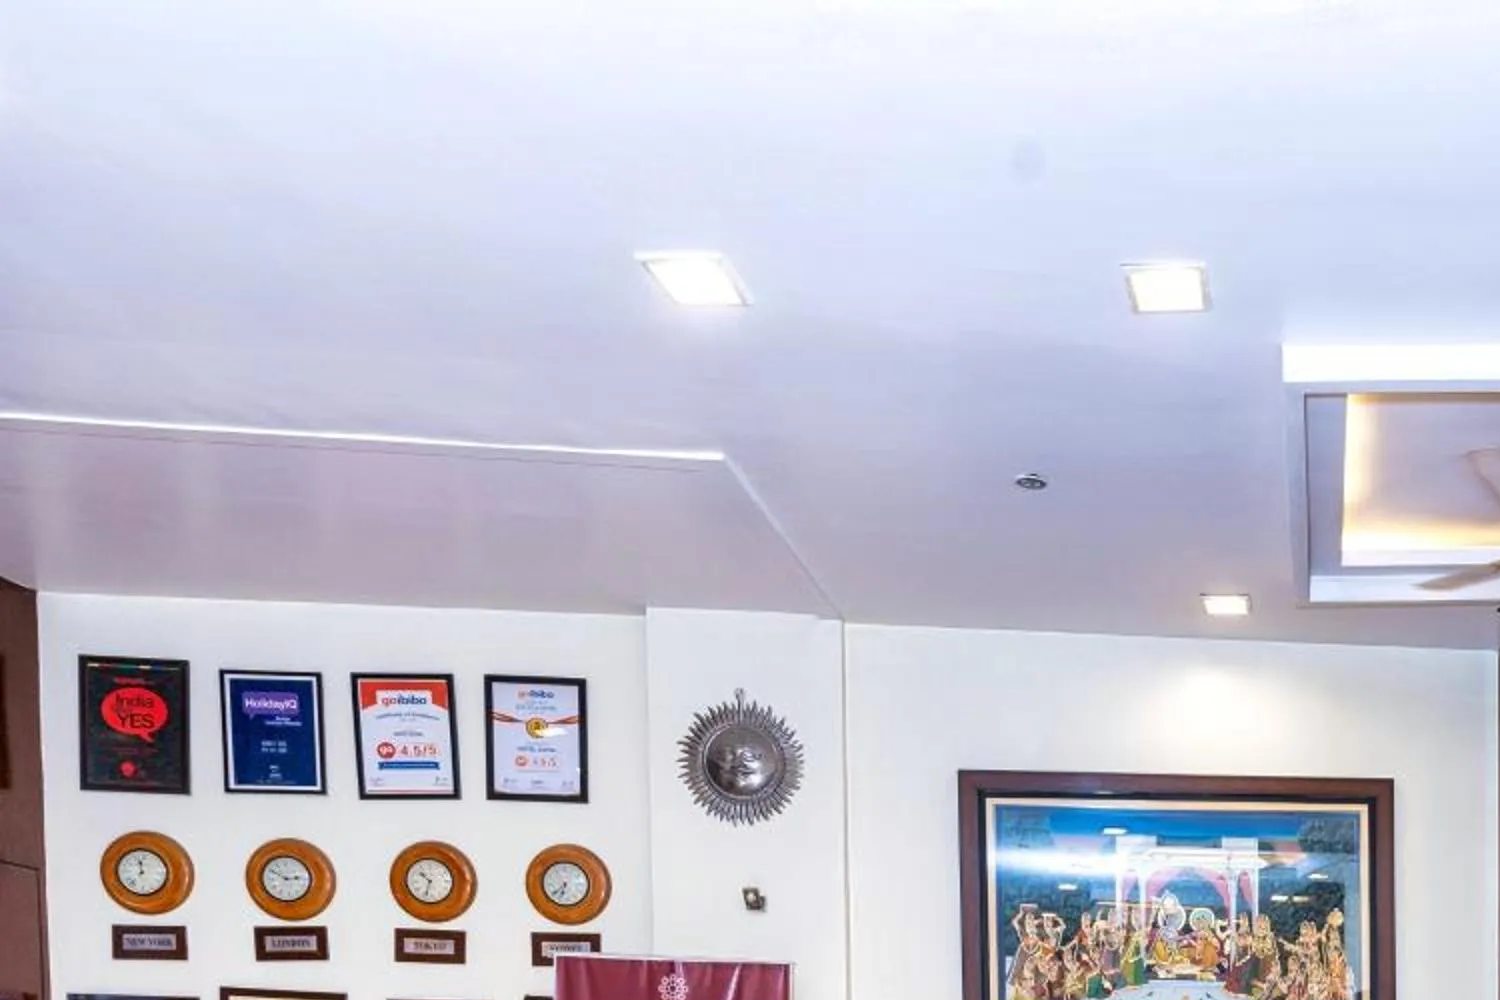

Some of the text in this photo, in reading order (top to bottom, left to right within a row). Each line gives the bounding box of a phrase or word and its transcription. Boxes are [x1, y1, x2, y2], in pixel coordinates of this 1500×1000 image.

[115, 694, 154, 708] India
[381, 695, 427, 707] goibibo
[117, 713, 155, 730] YES
